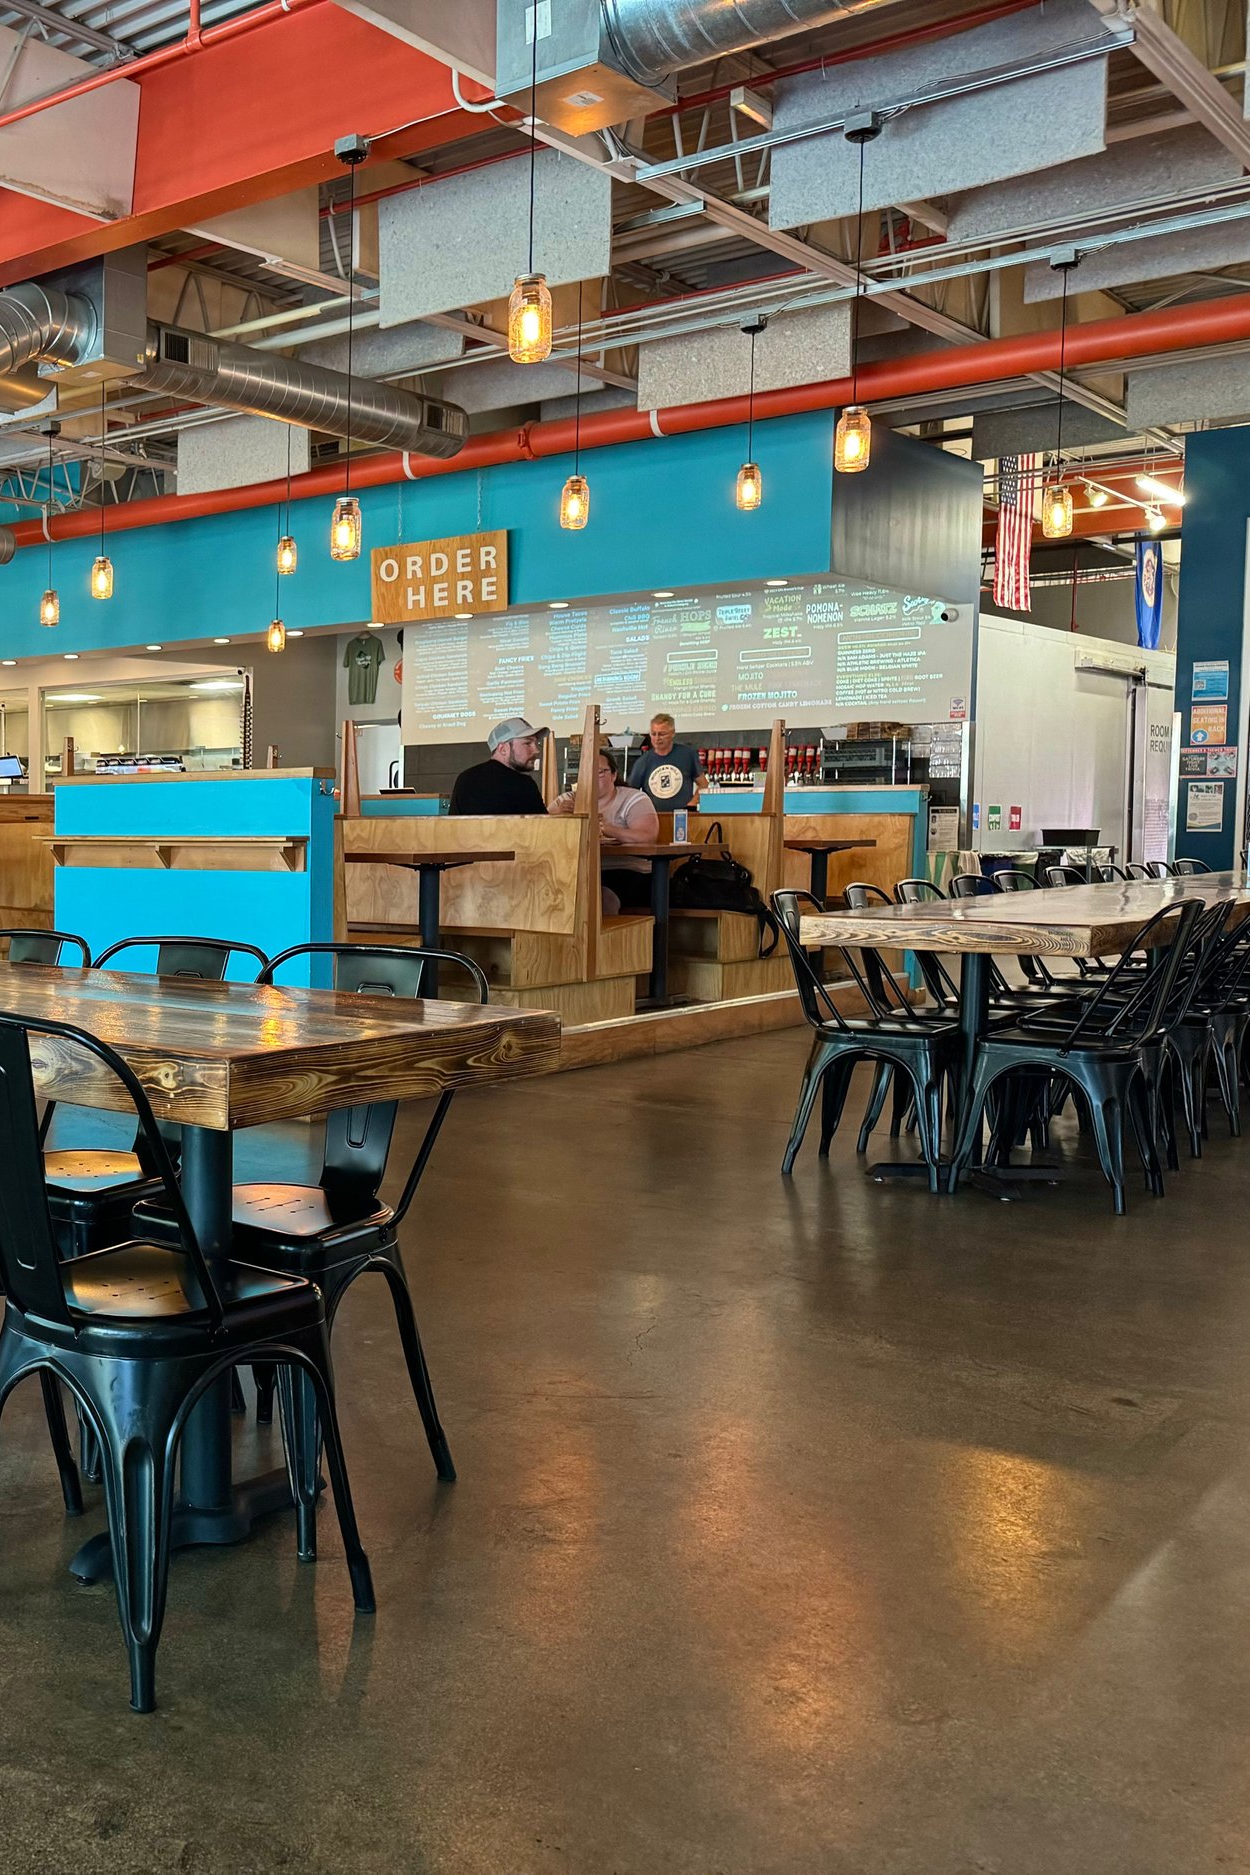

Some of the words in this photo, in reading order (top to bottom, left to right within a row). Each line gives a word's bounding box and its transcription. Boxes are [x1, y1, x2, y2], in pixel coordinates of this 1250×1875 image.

[379, 546, 497, 582] ORDER
[407, 577, 497, 609] HERE
[765, 594, 802, 605] VACATION
[806, 602, 843, 614] POMONA-
[850, 602, 897, 617] SCHATZ
[680, 610, 711, 622] HOPS
[807, 612, 843, 624] NOMENON
[763, 626, 802, 639] ZEST.
[738, 672, 763, 680] MOJITO
[651, 693, 676, 701] SHANDY
[700, 690, 716, 698] CURE
[738, 692, 767, 700] FROZEN
[768, 691, 798, 699] MOJITO
[1151, 725, 1169, 737] ROOM
